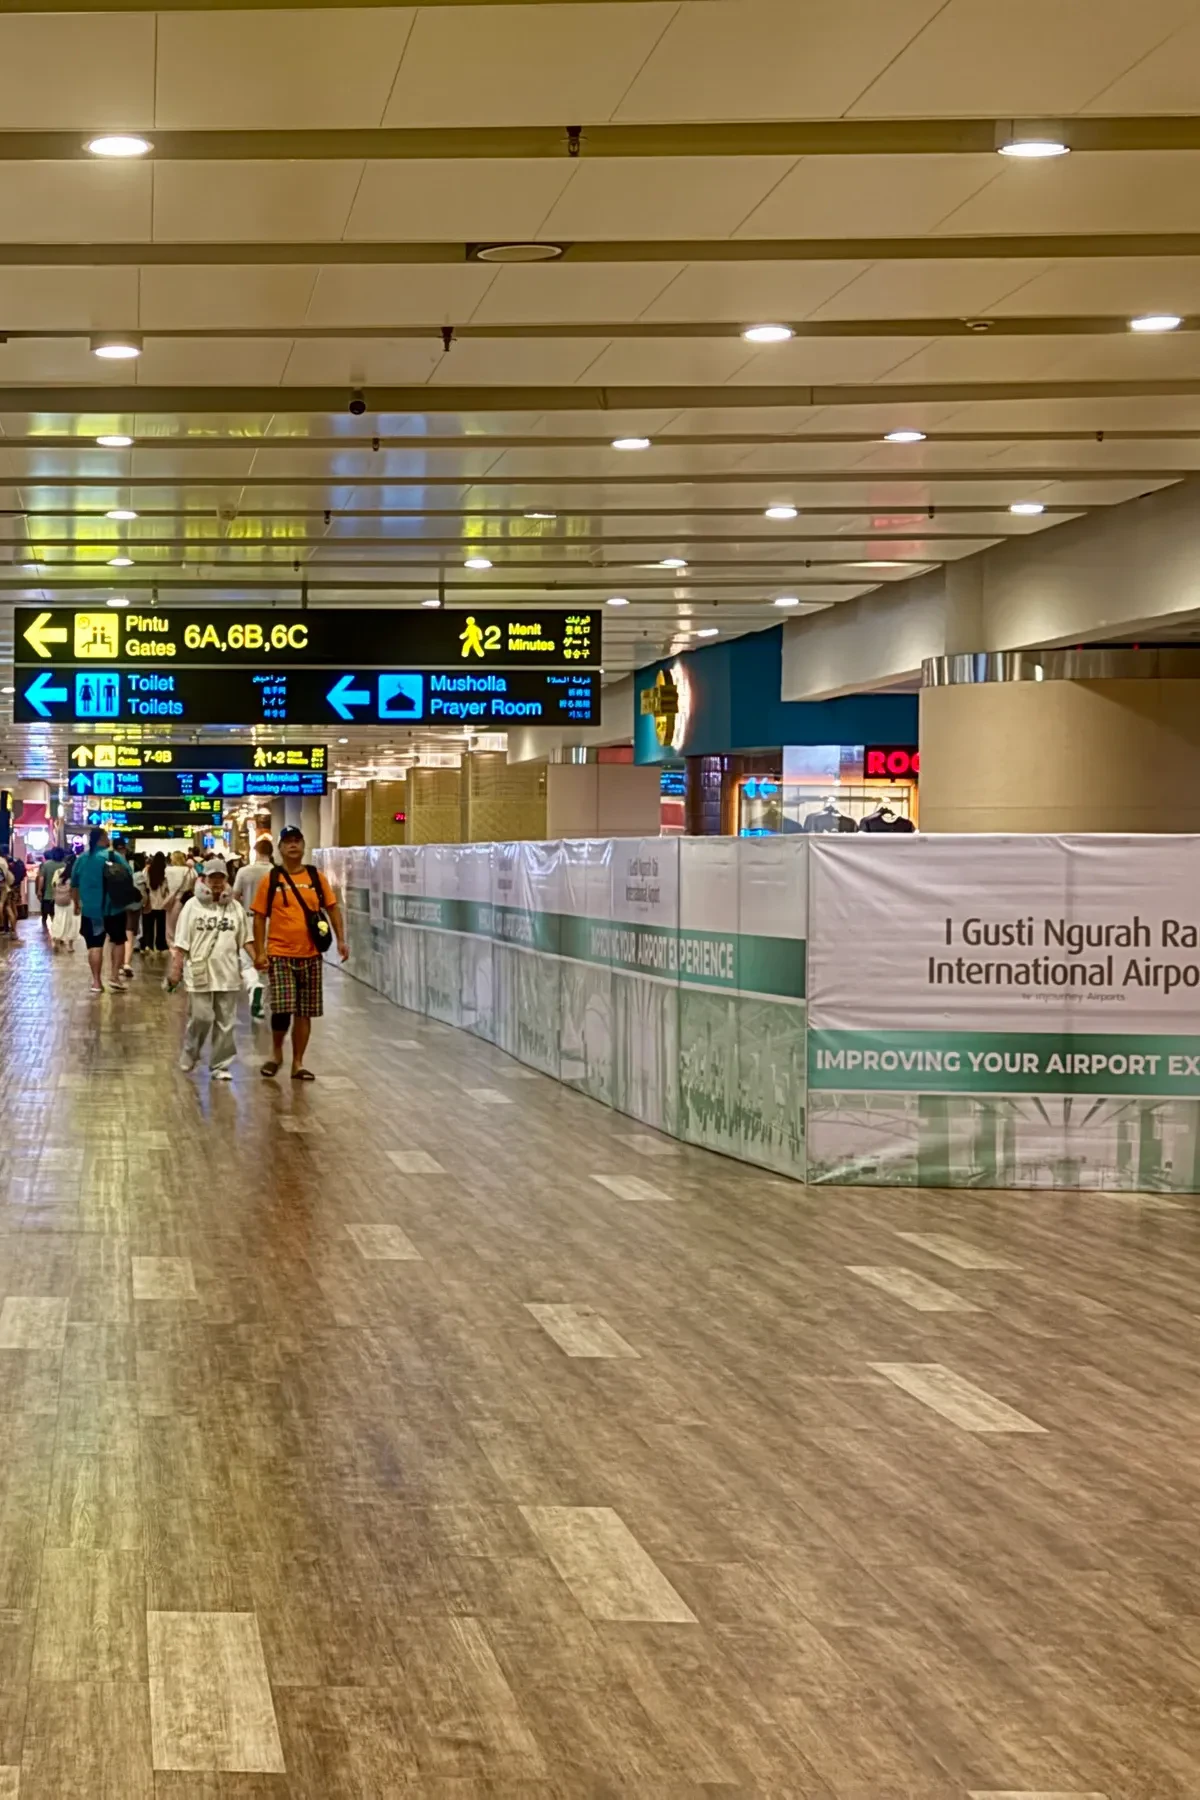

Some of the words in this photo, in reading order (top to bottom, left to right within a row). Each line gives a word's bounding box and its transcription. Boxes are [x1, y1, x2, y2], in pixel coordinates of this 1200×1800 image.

[126, 616, 169, 632] Pintu
[184, 624, 308, 651] 6A,6B,6C
[484, 625, 501, 650] 2
[508, 623, 541, 636] Menit
[125, 640, 176, 656] Gates
[508, 638, 555, 651] Minutes
[128, 675, 175, 691] Toilet
[430, 676, 506, 692] Musholla
[128, 698, 183, 714] Toilets
[430, 700, 486, 718] Prayer
[492, 700, 542, 715] Room
[144, 750, 172, 762] 7-9B
[266, 752, 285, 764] 1-2
[117, 774, 139, 782] Toilet
[246, 773, 265, 782] Area
[117, 784, 142, 792] Toilets
[246, 784, 280, 794] Smoking
[280, 784, 300, 792] Area
[946, 918, 952, 945] I
[962, 918, 1034, 946] Gusti
[1044, 916, 1150, 955] Ngurah
[1162, 920, 1197, 948] Ra
[638, 933, 666, 968] AIRPORT
[668, 937, 734, 979] EXPERIENCE
[929, 956, 1113, 986] International
[1122, 956, 1200, 994] Airpo
[816, 1050, 960, 1072] IMPROVING
[968, 1052, 1040, 1074] YOUR
[1046, 1054, 1161, 1076] AIRPORT
[1168, 1056, 1200, 1076] EX
